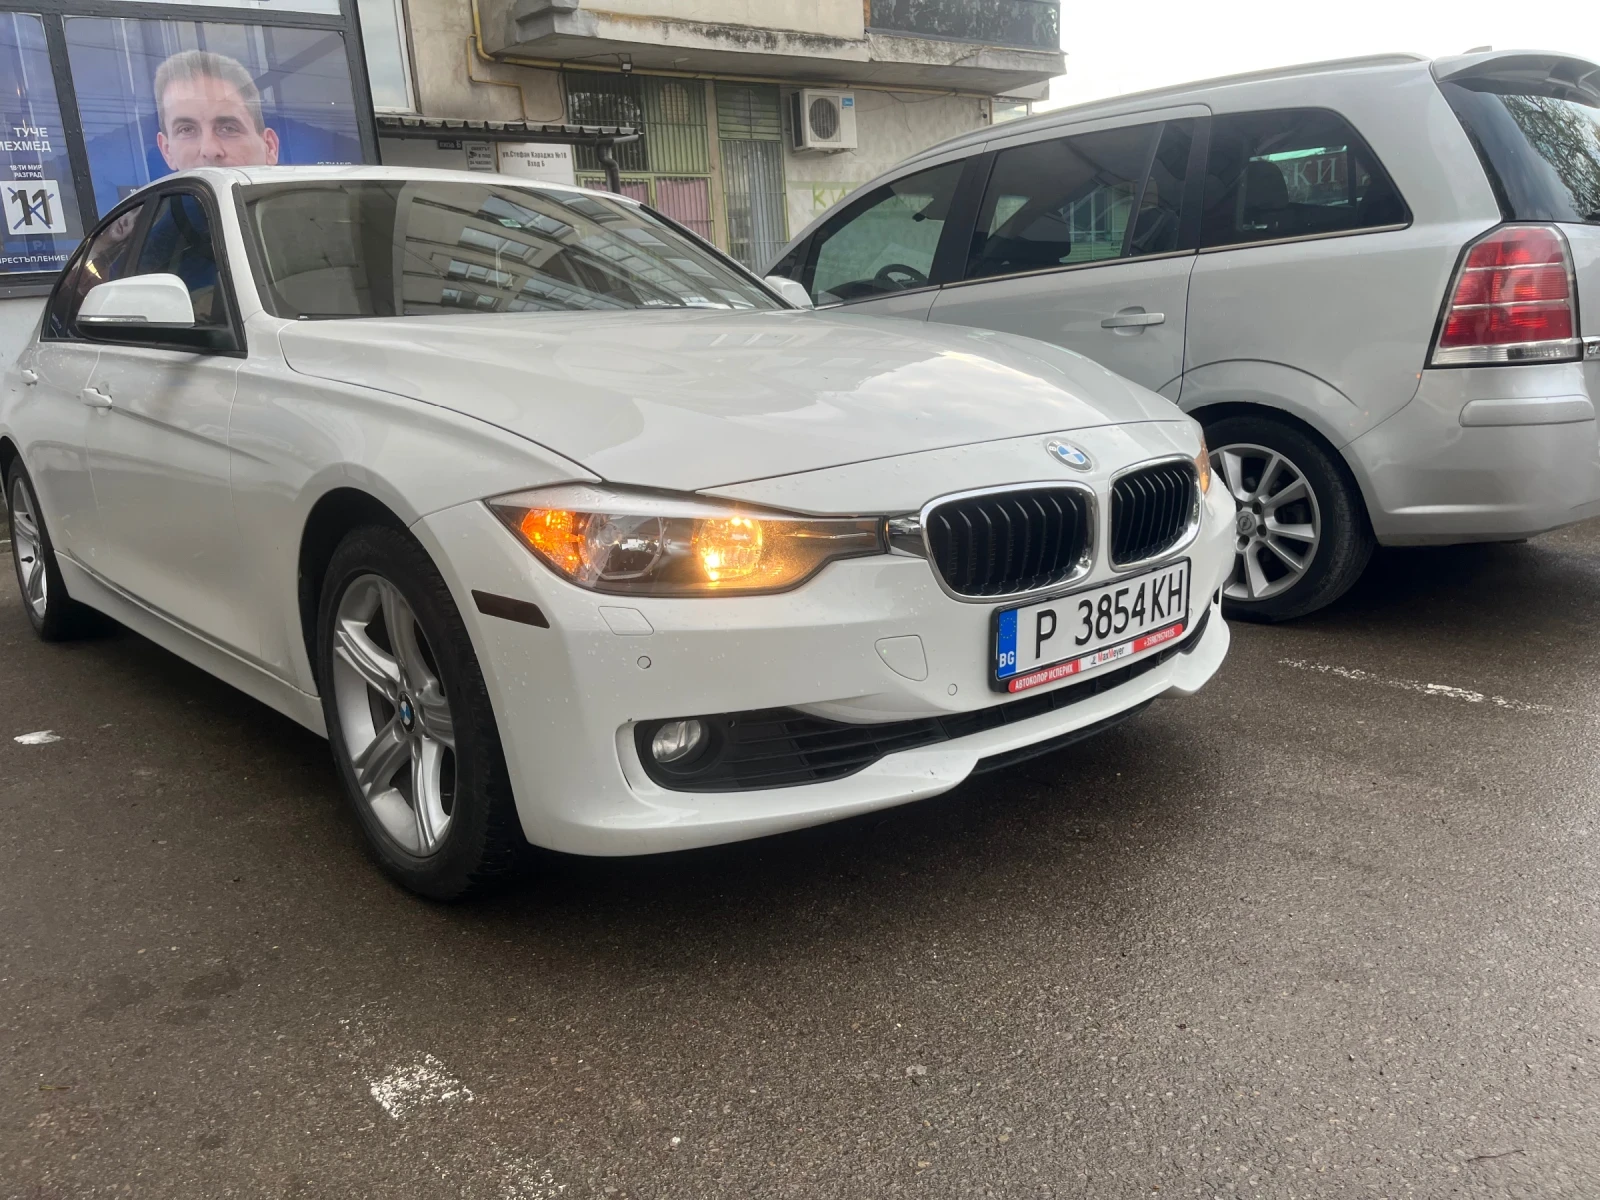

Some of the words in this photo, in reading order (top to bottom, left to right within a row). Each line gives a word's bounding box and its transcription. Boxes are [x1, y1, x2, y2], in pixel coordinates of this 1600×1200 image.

[13, 127, 49, 138] ТУЧЕ
[11, 189, 54, 226] 11
[0, 254, 69, 265] РЕСТЪПЛЕНИЕ!
[1035, 608, 1057, 660] P
[1000, 650, 1015, 668] BG
[1097, 646, 1125, 662] MaxMeyer
